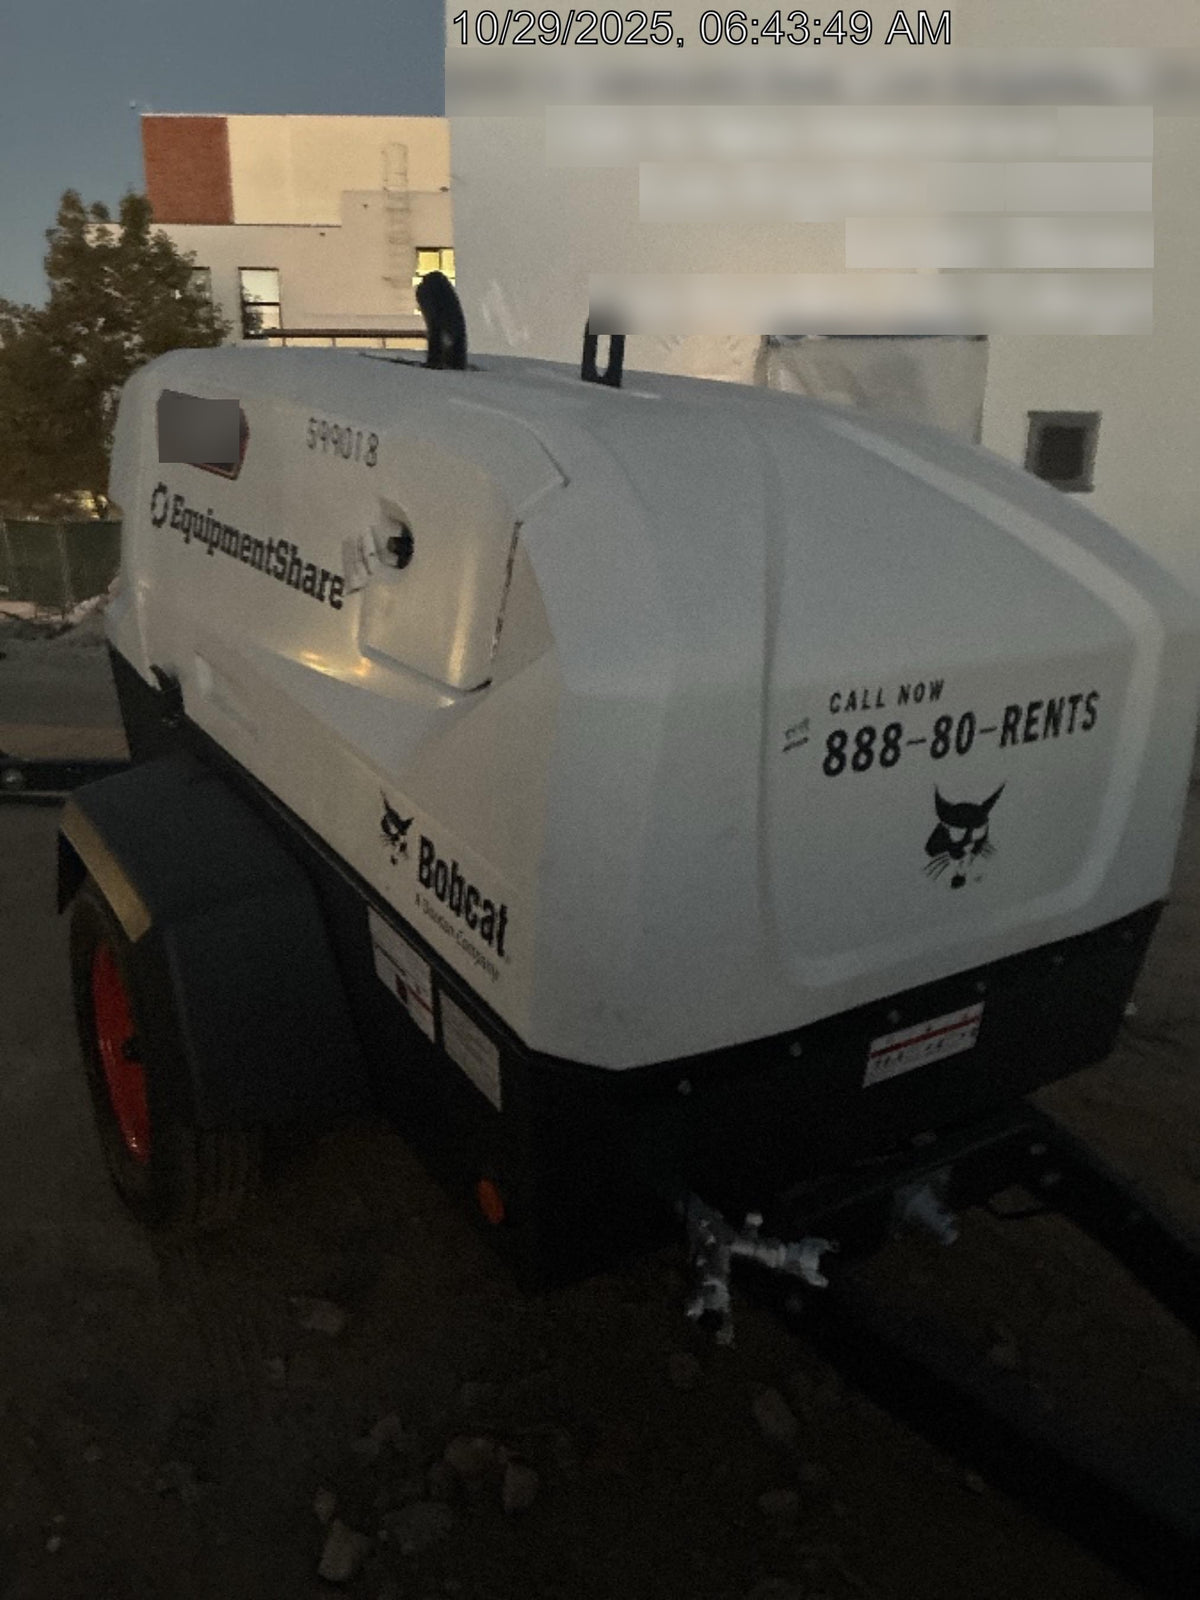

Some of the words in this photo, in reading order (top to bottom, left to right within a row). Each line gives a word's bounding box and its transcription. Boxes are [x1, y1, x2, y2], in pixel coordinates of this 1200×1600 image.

[306, 416, 380, 468] 599018
[169, 493, 345, 610] EquipmentShare
[822, 690, 1101, 777] 888-80-RENTS
[829, 688, 886, 714] CALL
[897, 678, 946, 706] NOW
[418, 834, 509, 958] Bobcat
